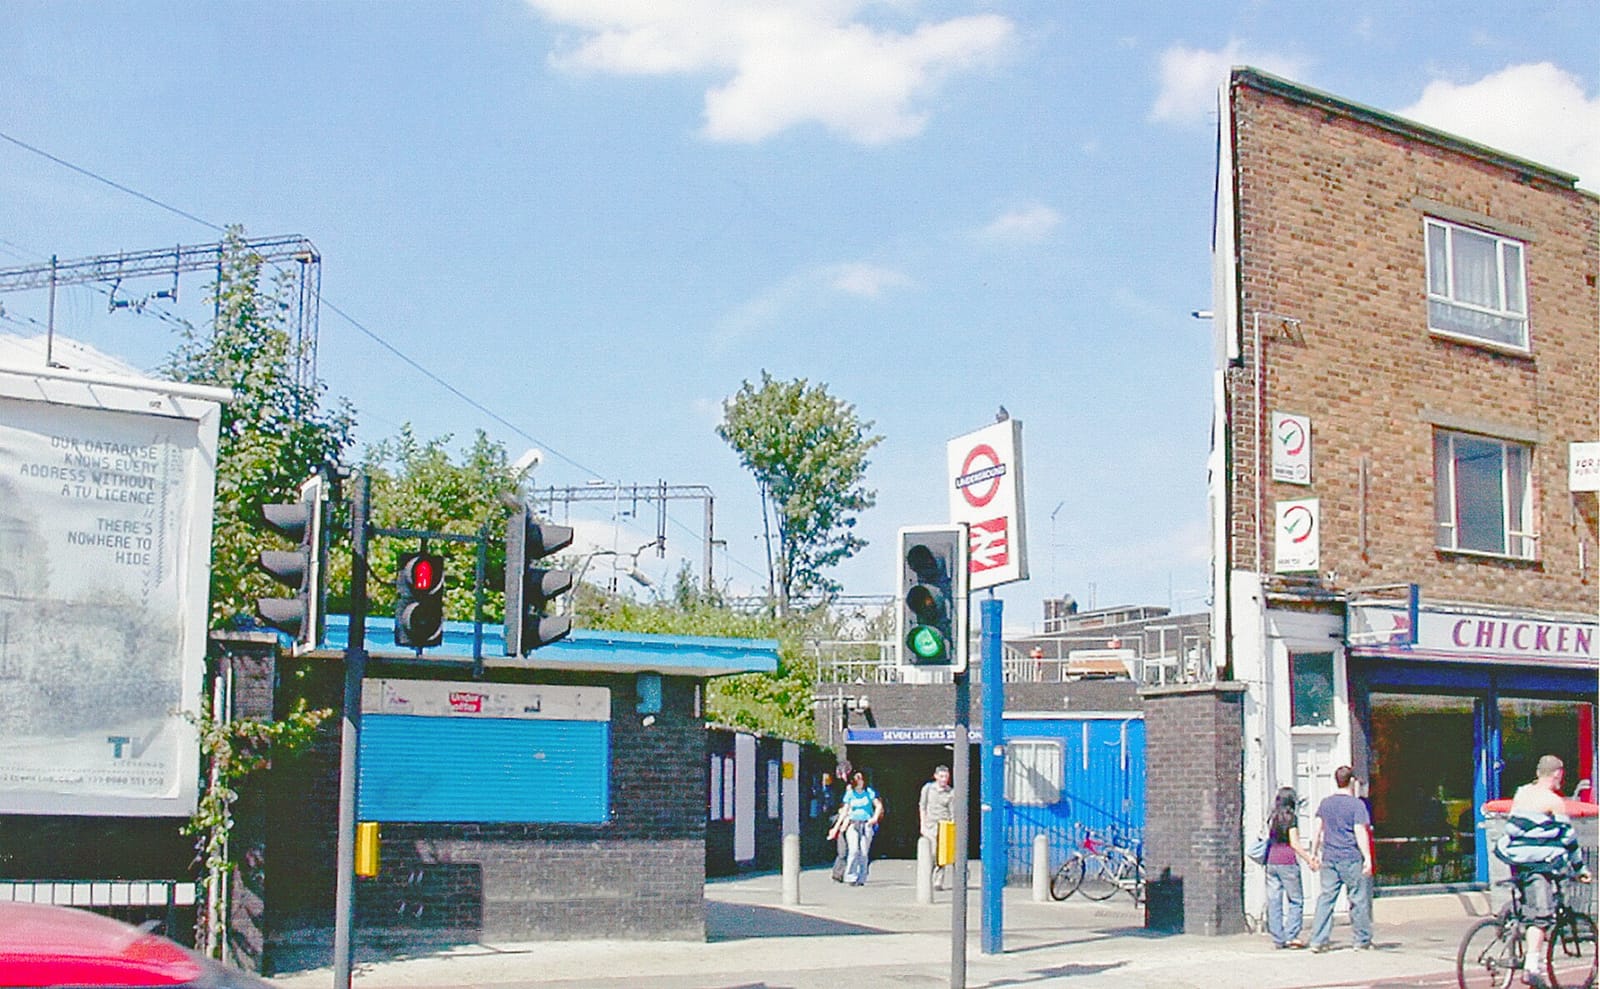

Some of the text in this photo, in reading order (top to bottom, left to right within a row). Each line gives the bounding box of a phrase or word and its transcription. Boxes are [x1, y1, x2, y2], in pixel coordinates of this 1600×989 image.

[51, 435, 158, 460] OUR DATABASE
[64, 453, 110, 470] KNOWS
[115, 458, 159, 474] EVERY
[20, 463, 156, 491] ADDRESS WITHOUT
[61, 483, 156, 505] A TV LICENCE
[97, 517, 153, 536] THERE'S
[67, 531, 152, 551] NOWHERE TO
[115, 552, 151, 567] HIDE
[1452, 618, 1593, 655] CHICKEN
[883, 730, 983, 740] SEVEN SISTERS STON
